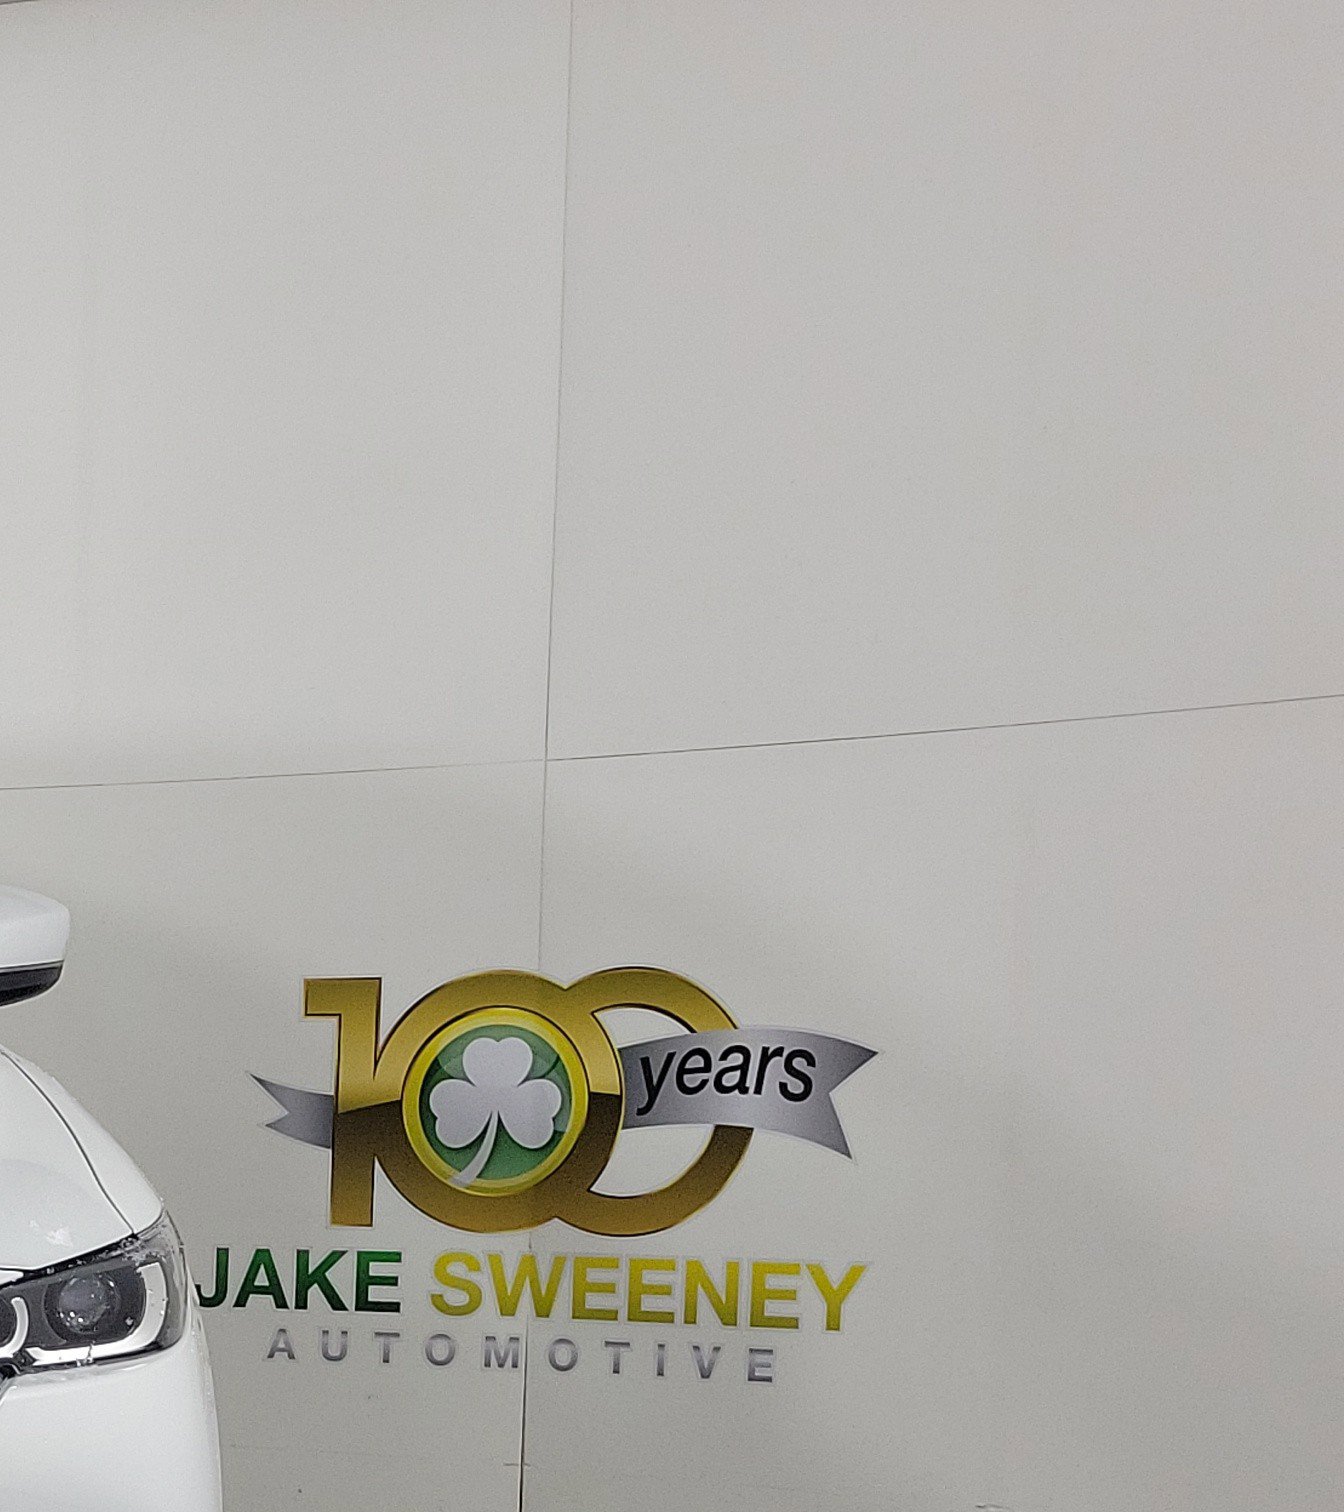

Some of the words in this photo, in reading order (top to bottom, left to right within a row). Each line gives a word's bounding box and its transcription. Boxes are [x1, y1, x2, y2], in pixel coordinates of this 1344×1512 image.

[303, 966, 755, 1236] 100
[636, 1045, 817, 1116] years
[195, 1247, 402, 1314] JAKE
[430, 1252, 868, 1332] SWEENEY
[266, 1328, 776, 1384] AUTOMOTIVE
